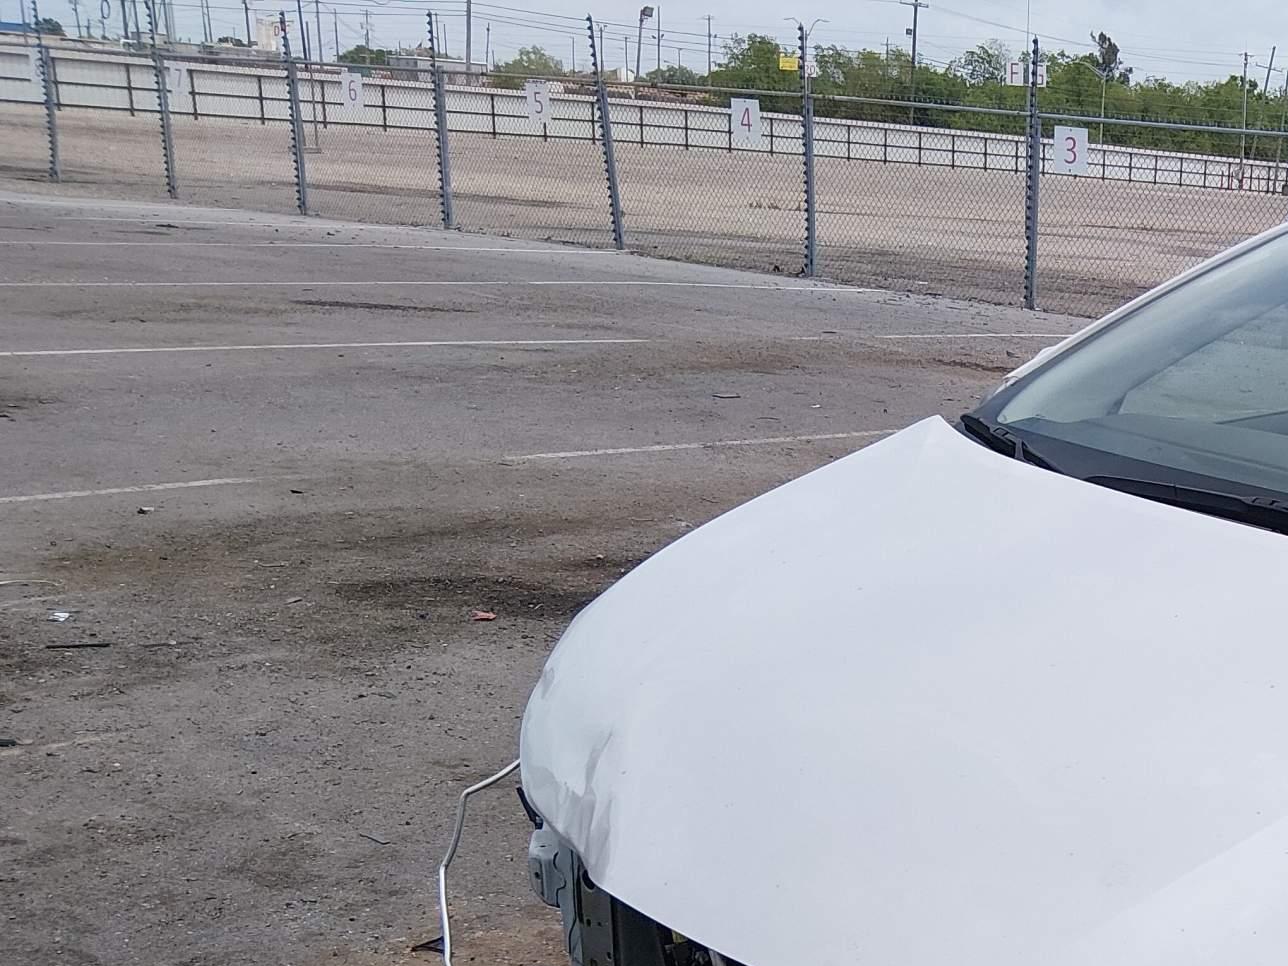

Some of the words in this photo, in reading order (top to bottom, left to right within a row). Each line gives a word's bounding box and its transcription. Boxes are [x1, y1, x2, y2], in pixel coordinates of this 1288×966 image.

[1010, 62, 1019, 84] F
[347, 79, 357, 101] 6
[533, 91, 544, 114] 5
[740, 107, 753, 133] 4
[1064, 136, 1077, 164] 3
